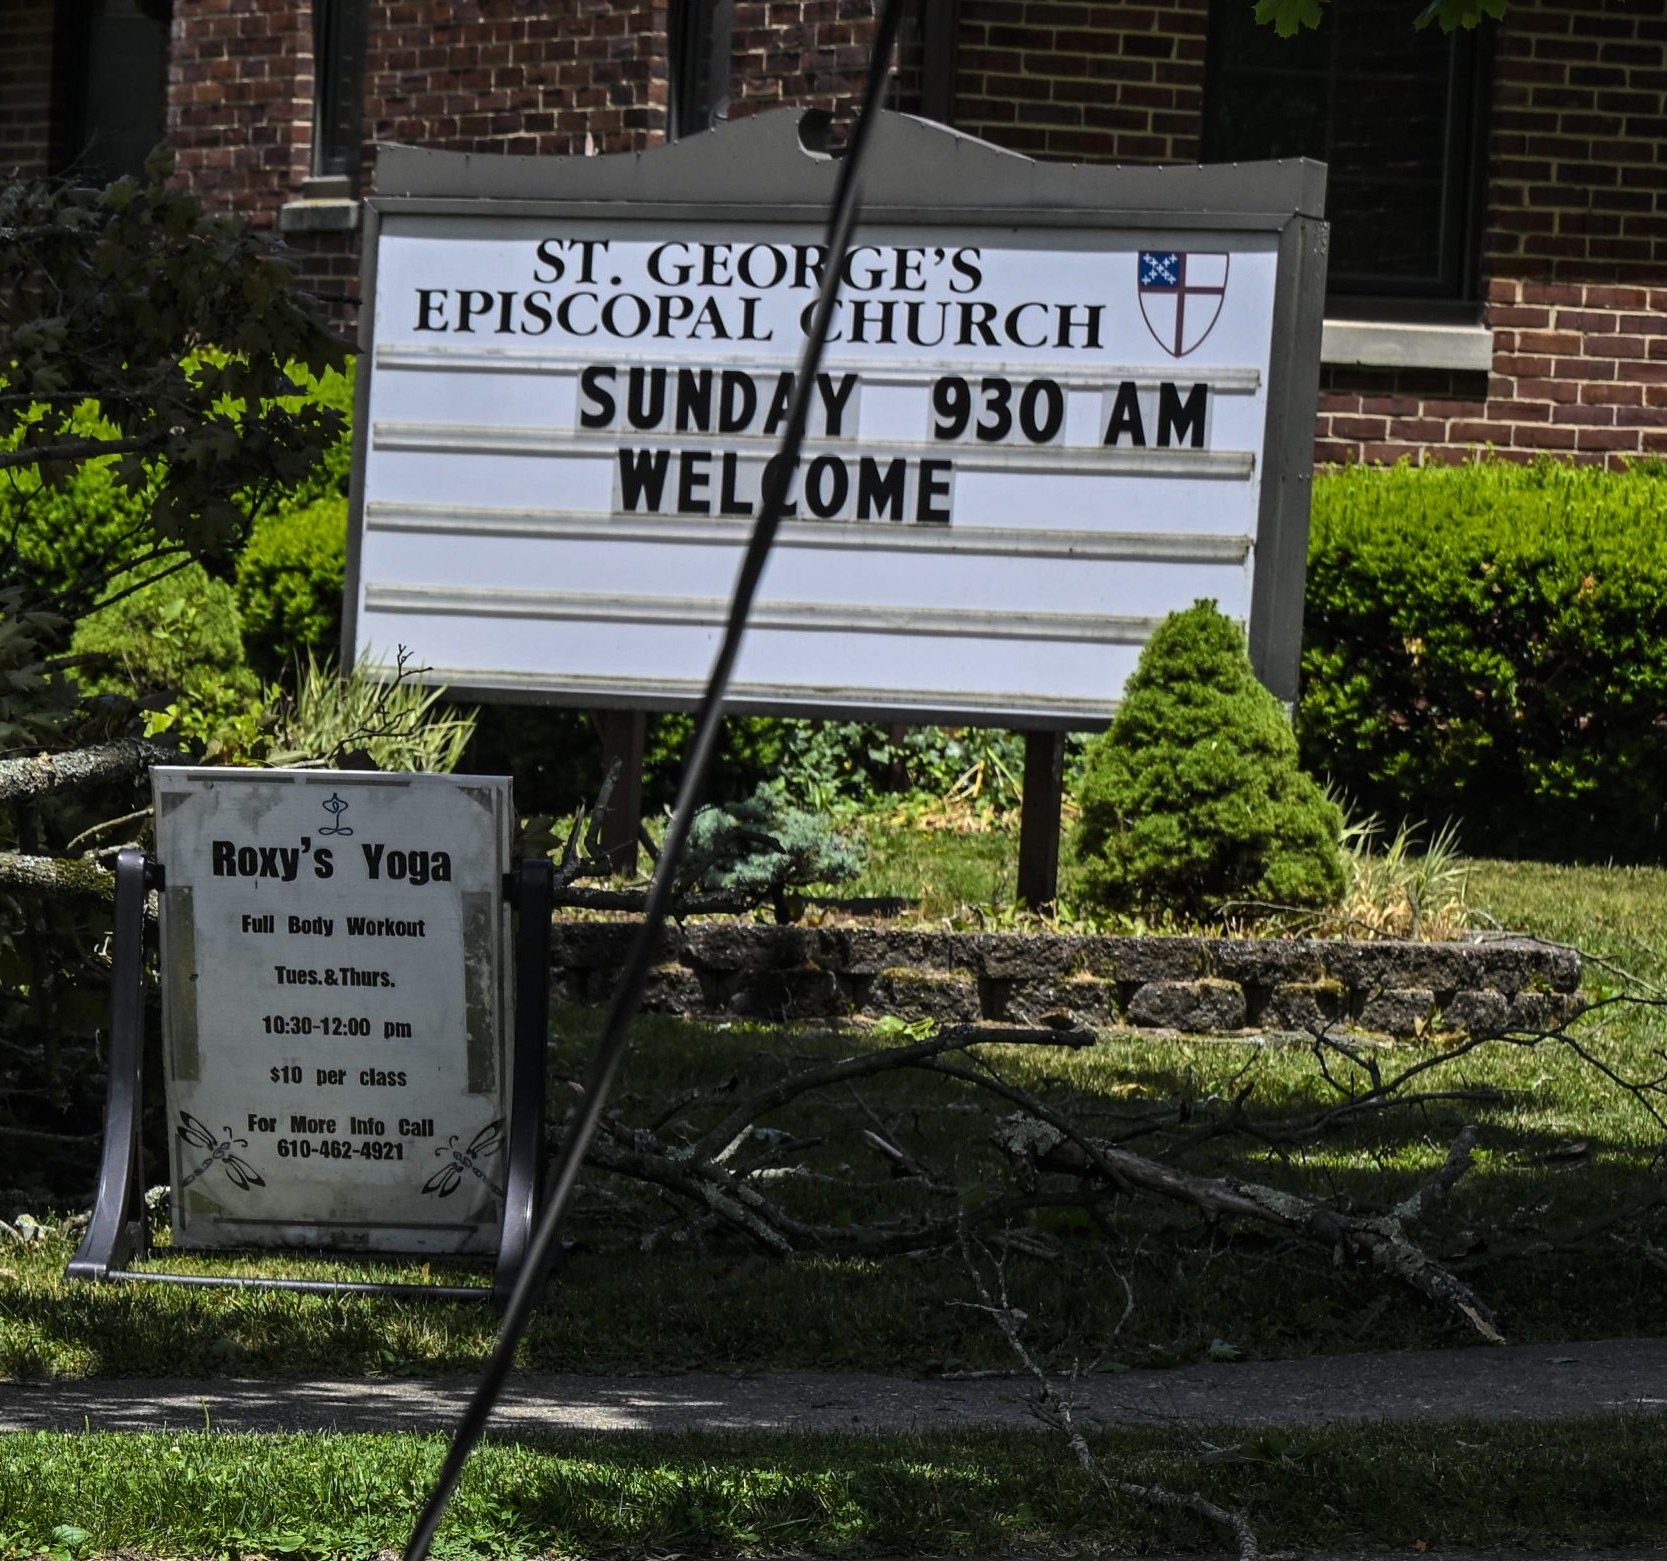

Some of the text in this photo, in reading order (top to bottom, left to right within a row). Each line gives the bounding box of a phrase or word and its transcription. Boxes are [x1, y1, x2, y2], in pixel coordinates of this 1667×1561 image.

[533, 239, 984, 293] ST. GEORGE'S
[413, 288, 1107, 349] EPISCOPAL CHURCH
[579, 365, 1209, 448] SUNDAY 930 AM
[212, 836, 452, 886] Roxy's Yoga
[241, 914, 426, 938] Full Body Workout
[262, 1015, 412, 1039] 10:30-12:00 pm
[270, 1066, 407, 1086] $10 per class
[247, 1113, 434, 1137] For More Info Call
[277, 1138, 404, 1160] 610-462-4921
